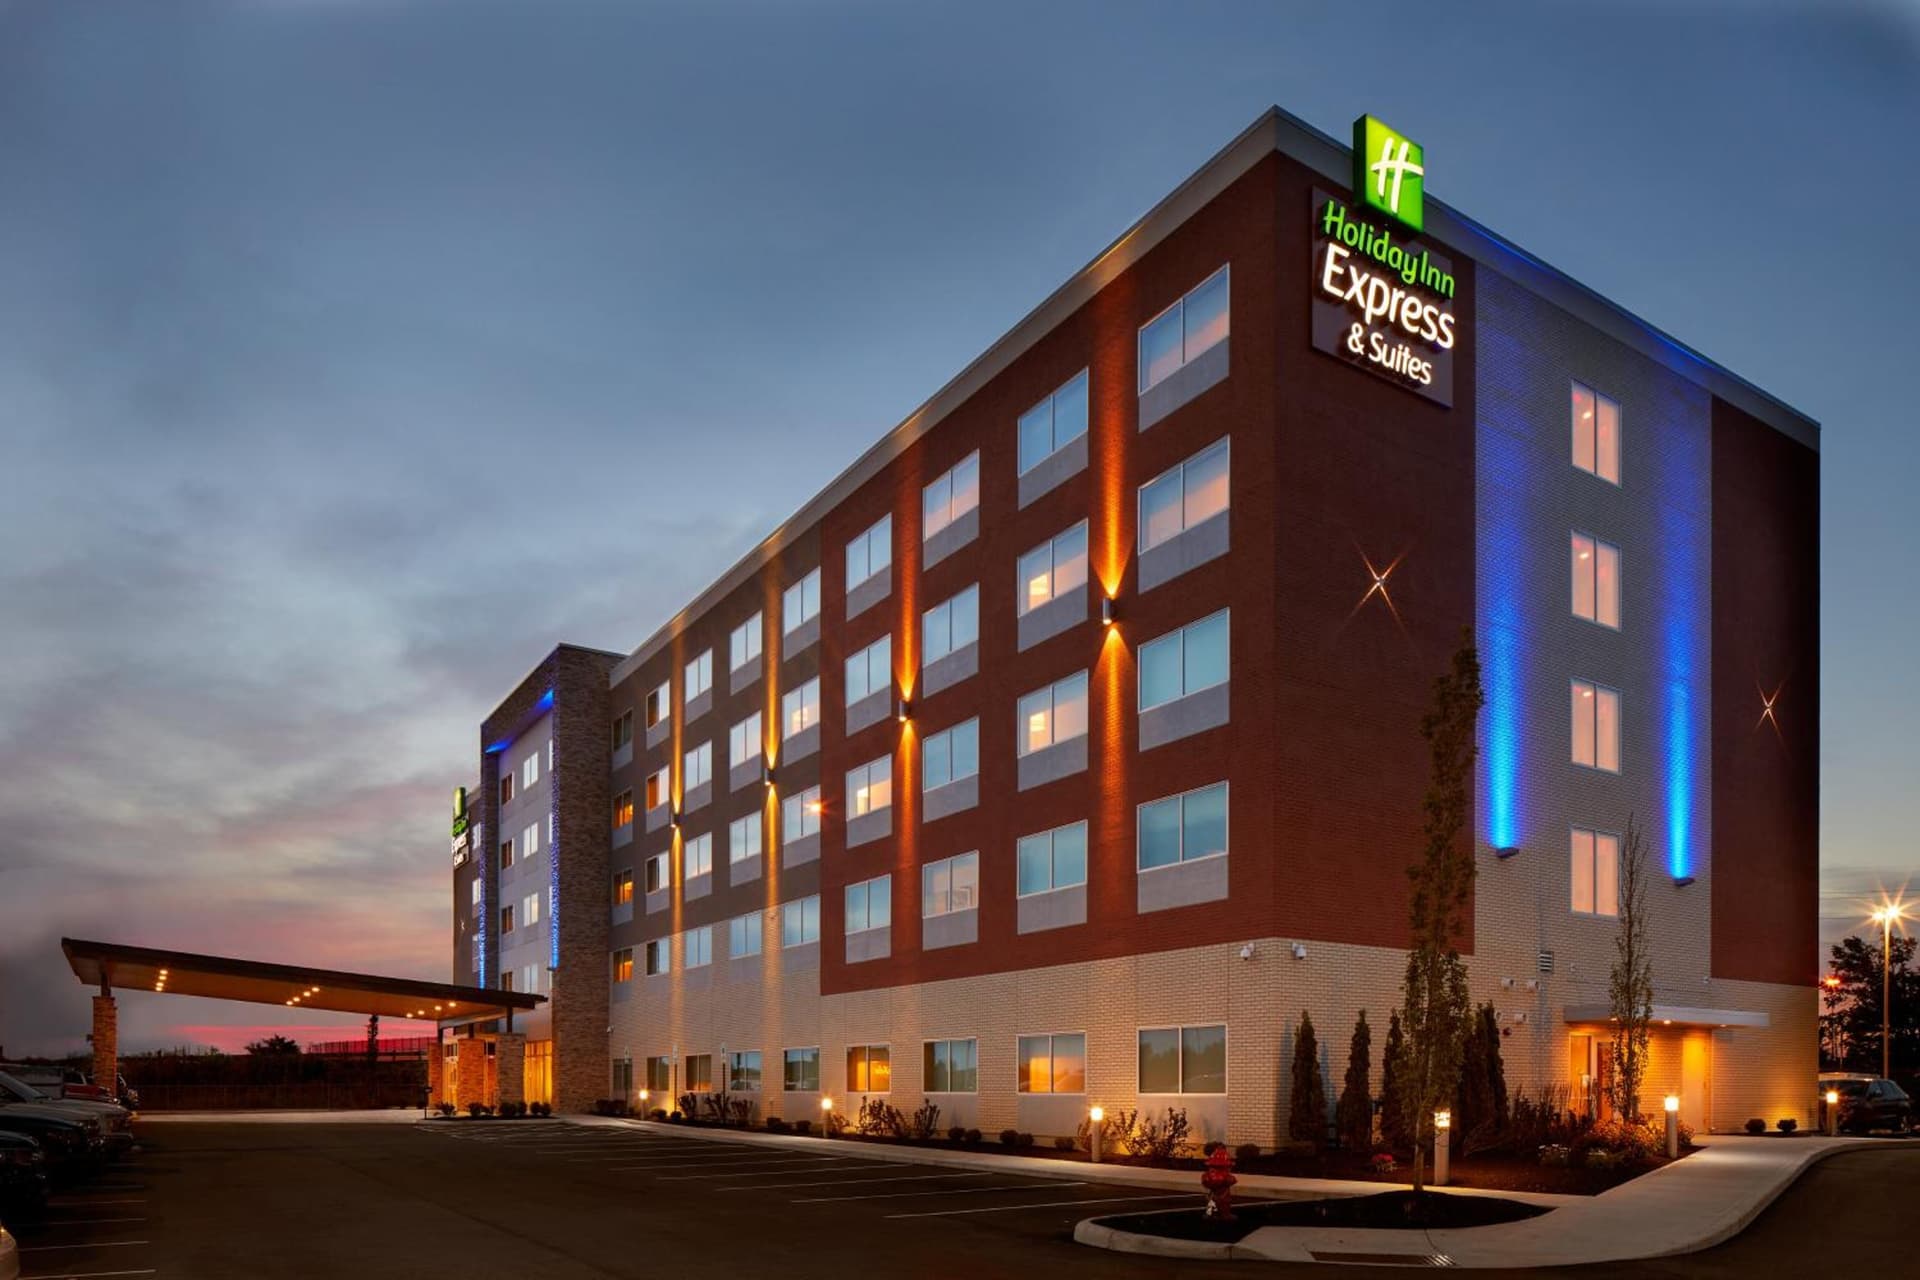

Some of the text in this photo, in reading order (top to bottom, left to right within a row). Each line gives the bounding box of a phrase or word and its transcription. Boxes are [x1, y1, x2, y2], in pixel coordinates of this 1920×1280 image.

[1322, 200, 1455, 298] Holiday Inn
[1322, 242, 1455, 350] Express
[1347, 322, 1432, 386] & Suites
